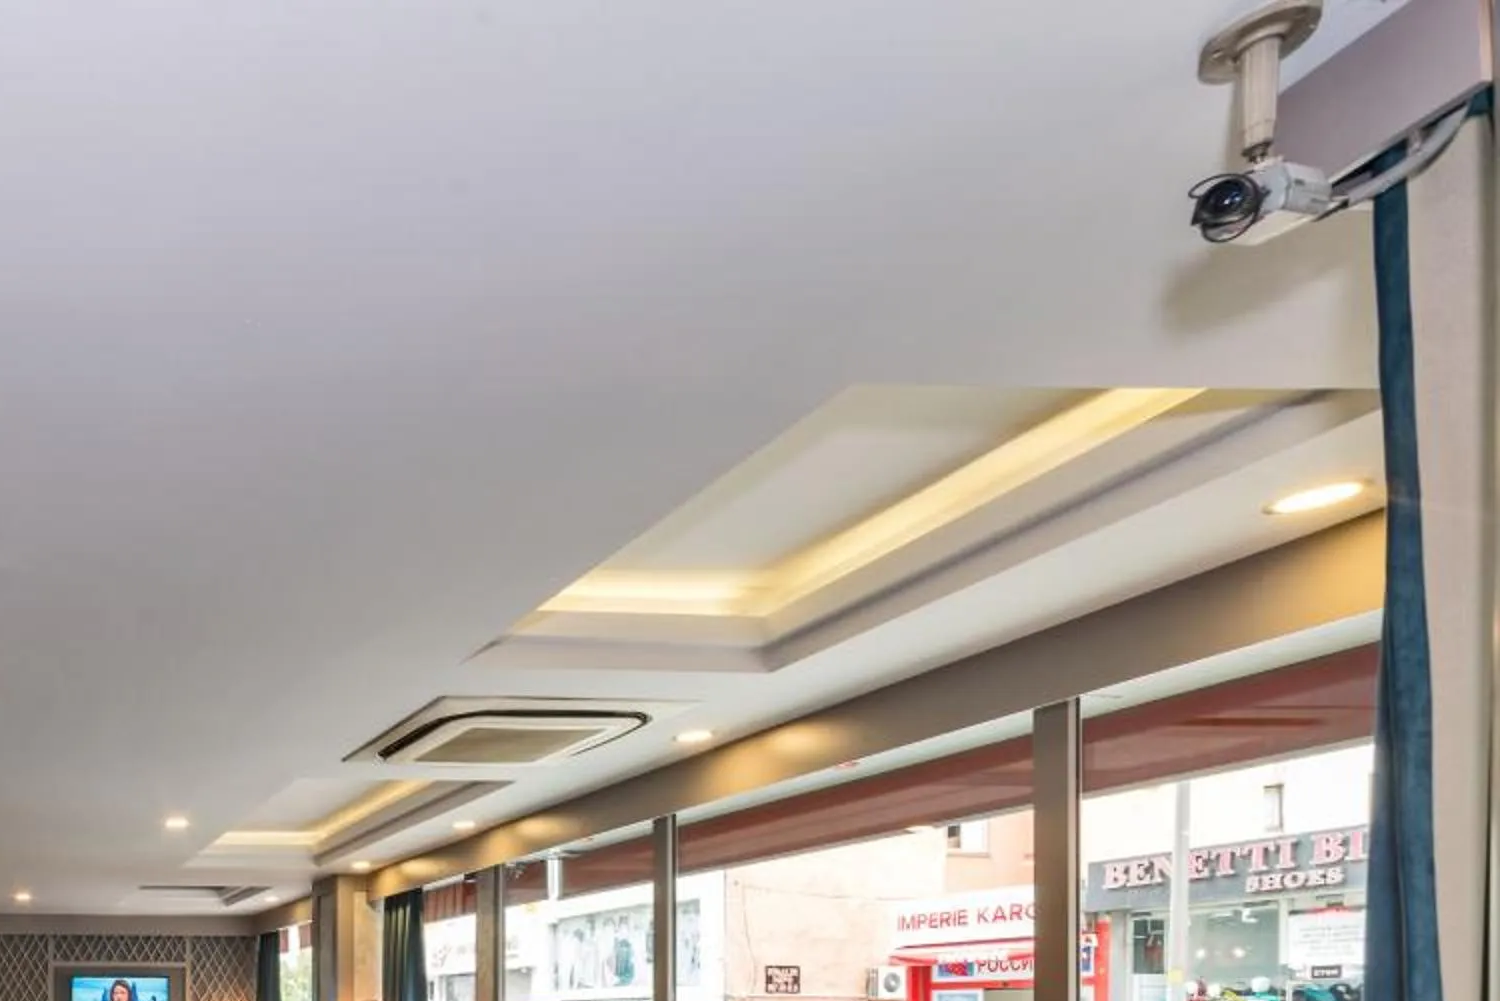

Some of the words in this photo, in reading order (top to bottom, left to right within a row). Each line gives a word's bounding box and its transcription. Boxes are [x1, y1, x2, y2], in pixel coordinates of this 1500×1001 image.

[1103, 839, 1298, 889] BENETTI
[1247, 867, 1344, 893] SHOES
[897, 909, 968, 931] IMPERIE
